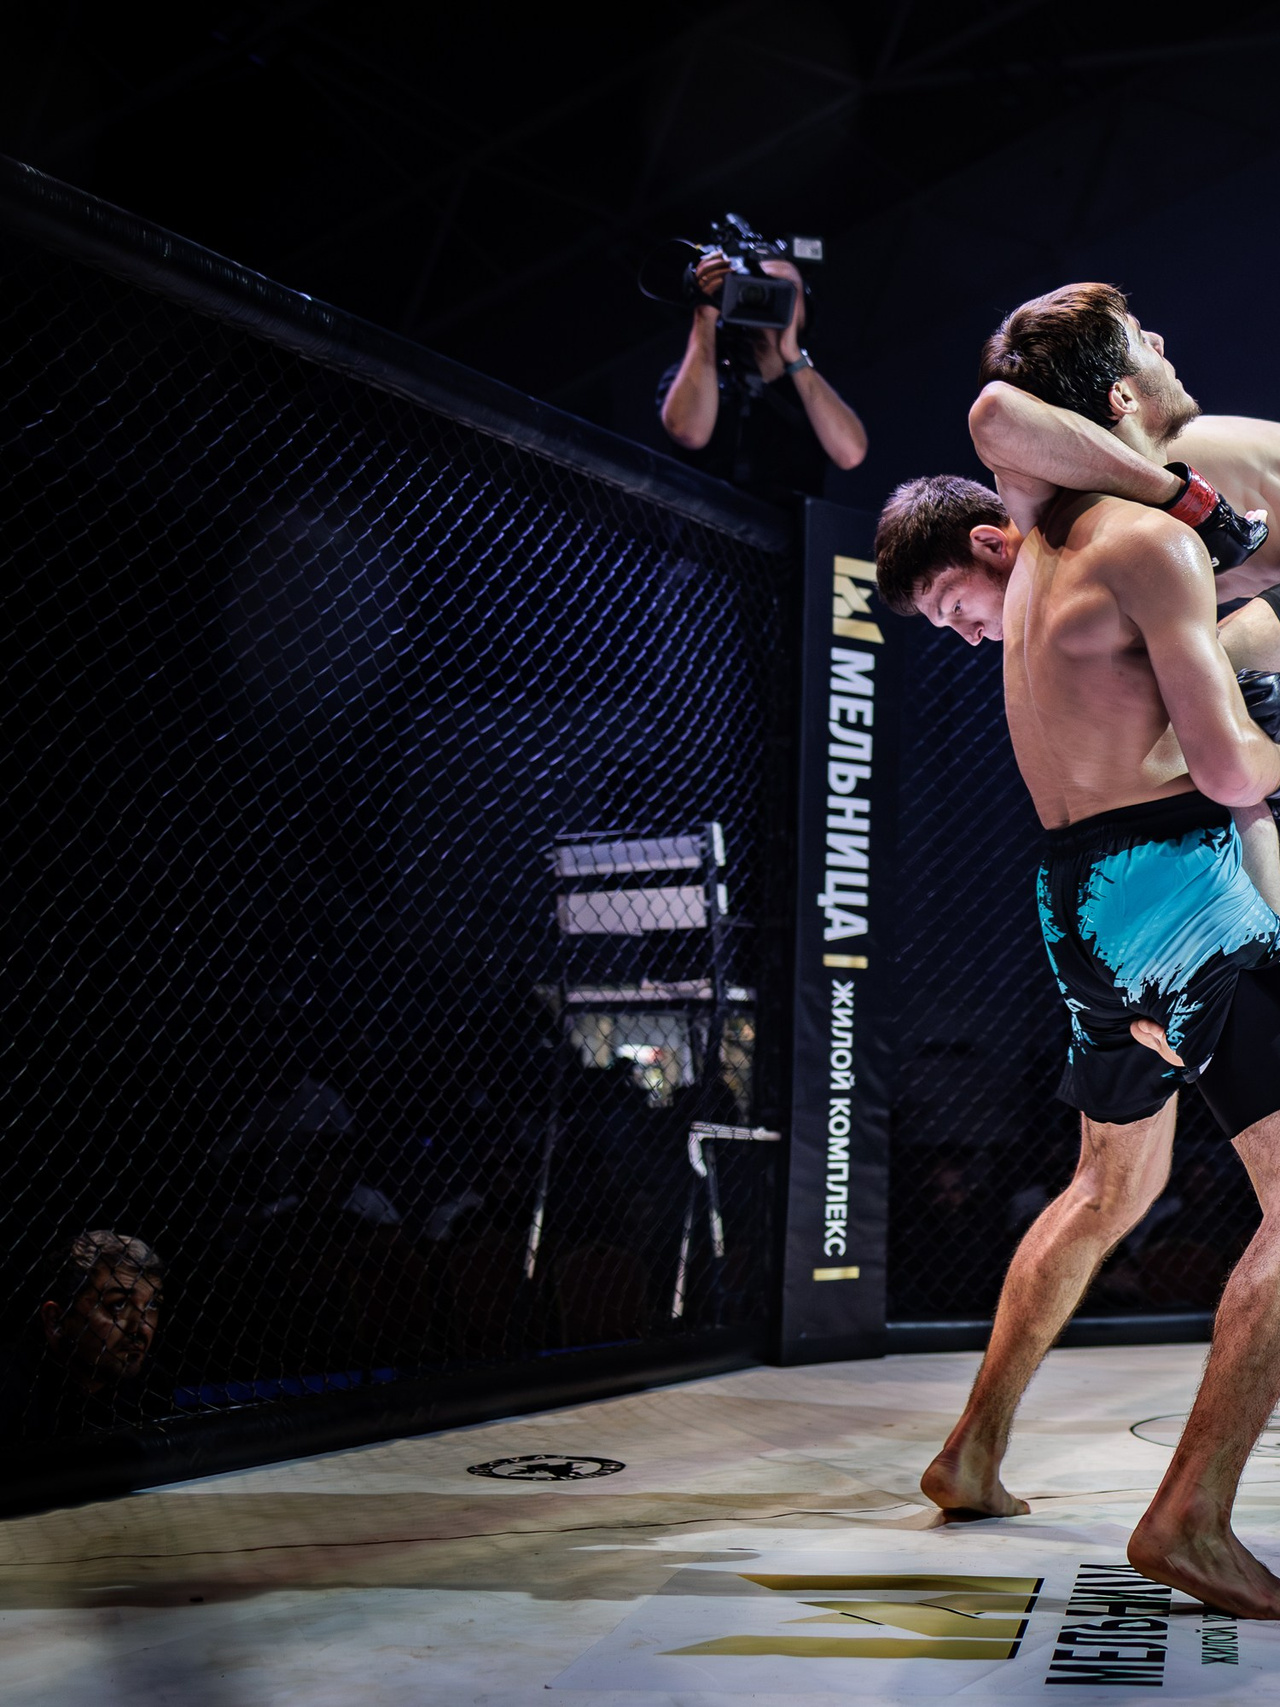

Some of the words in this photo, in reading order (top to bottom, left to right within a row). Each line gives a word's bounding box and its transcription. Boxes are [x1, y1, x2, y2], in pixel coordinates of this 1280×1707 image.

[816, 646, 876, 942] МЕЛЬНИЦА
[829, 979, 856, 1091] ЖИЛОЙ
[823, 1097, 852, 1257] КОМПЛЕКС
[1195, 1626, 1239, 1665] ЖИЛОЙ
